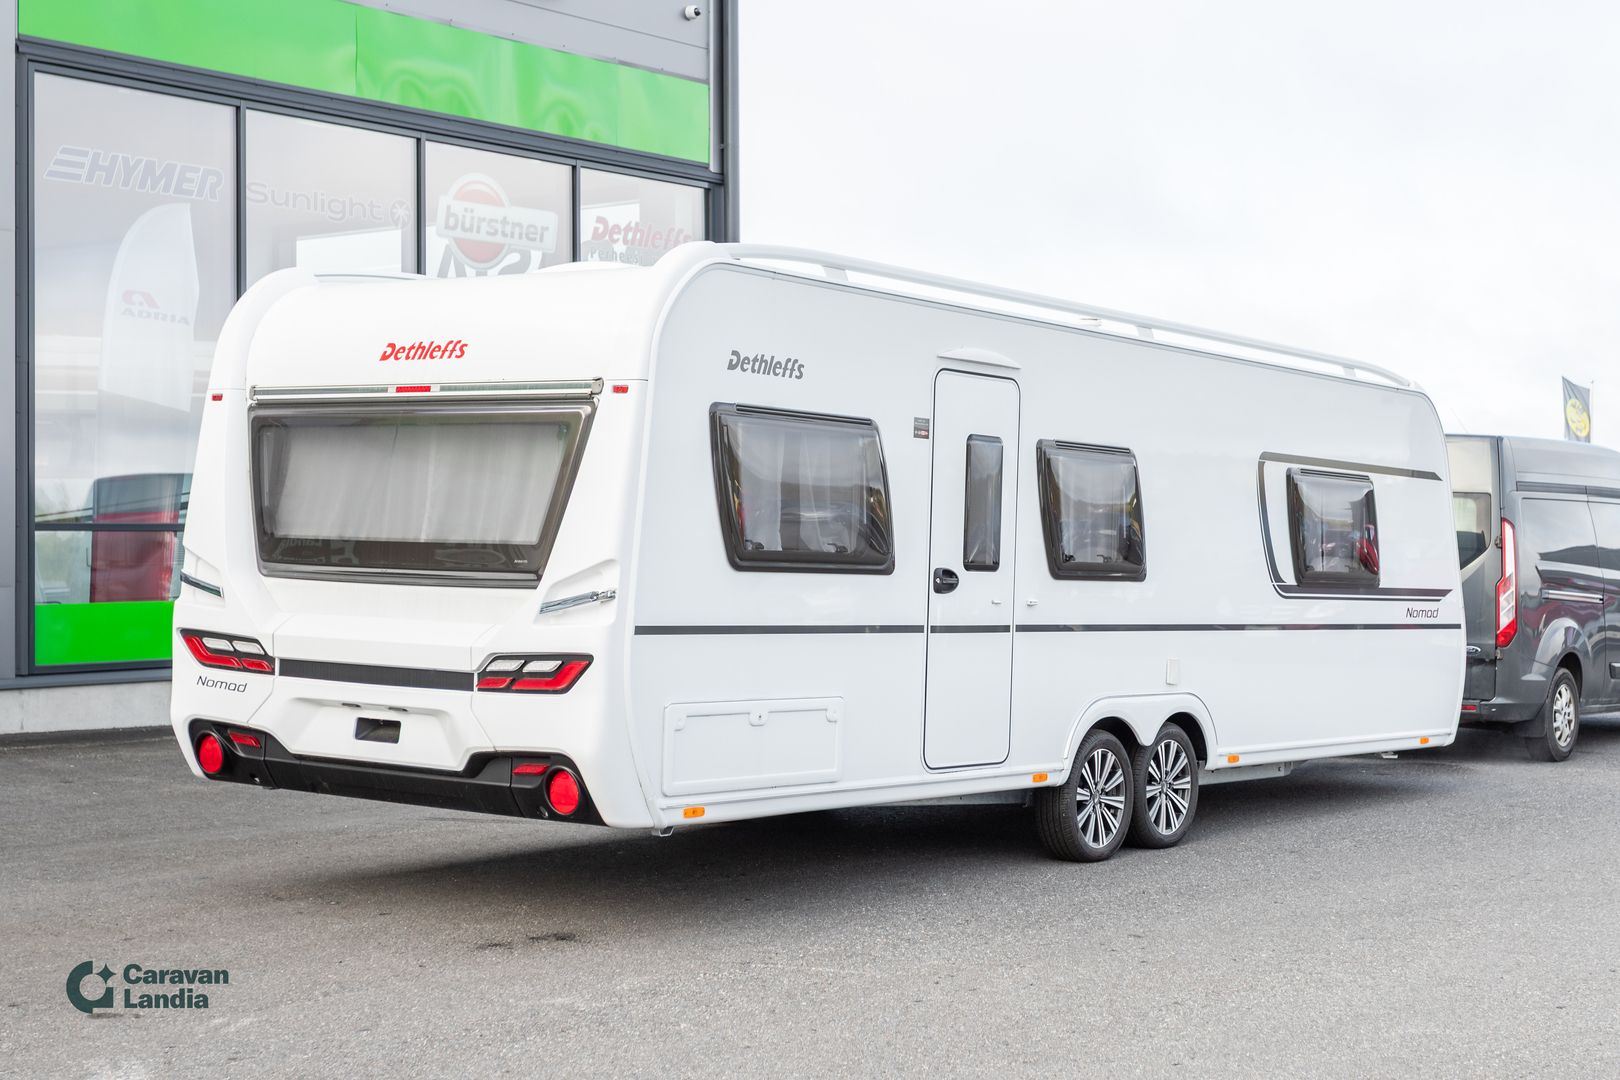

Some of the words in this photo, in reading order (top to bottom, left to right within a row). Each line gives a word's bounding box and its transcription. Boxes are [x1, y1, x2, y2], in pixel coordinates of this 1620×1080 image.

[84, 150, 225, 201] HYMER
[247, 182, 384, 222] Sunlight
[444, 204, 549, 243] bürstner
[120, 307, 190, 326] ADRIA
[379, 340, 468, 361] Dethleffs
[727, 349, 805, 380] Dethleffs
[1405, 607, 1440, 619] Nomad
[196, 675, 248, 693] Nomad
